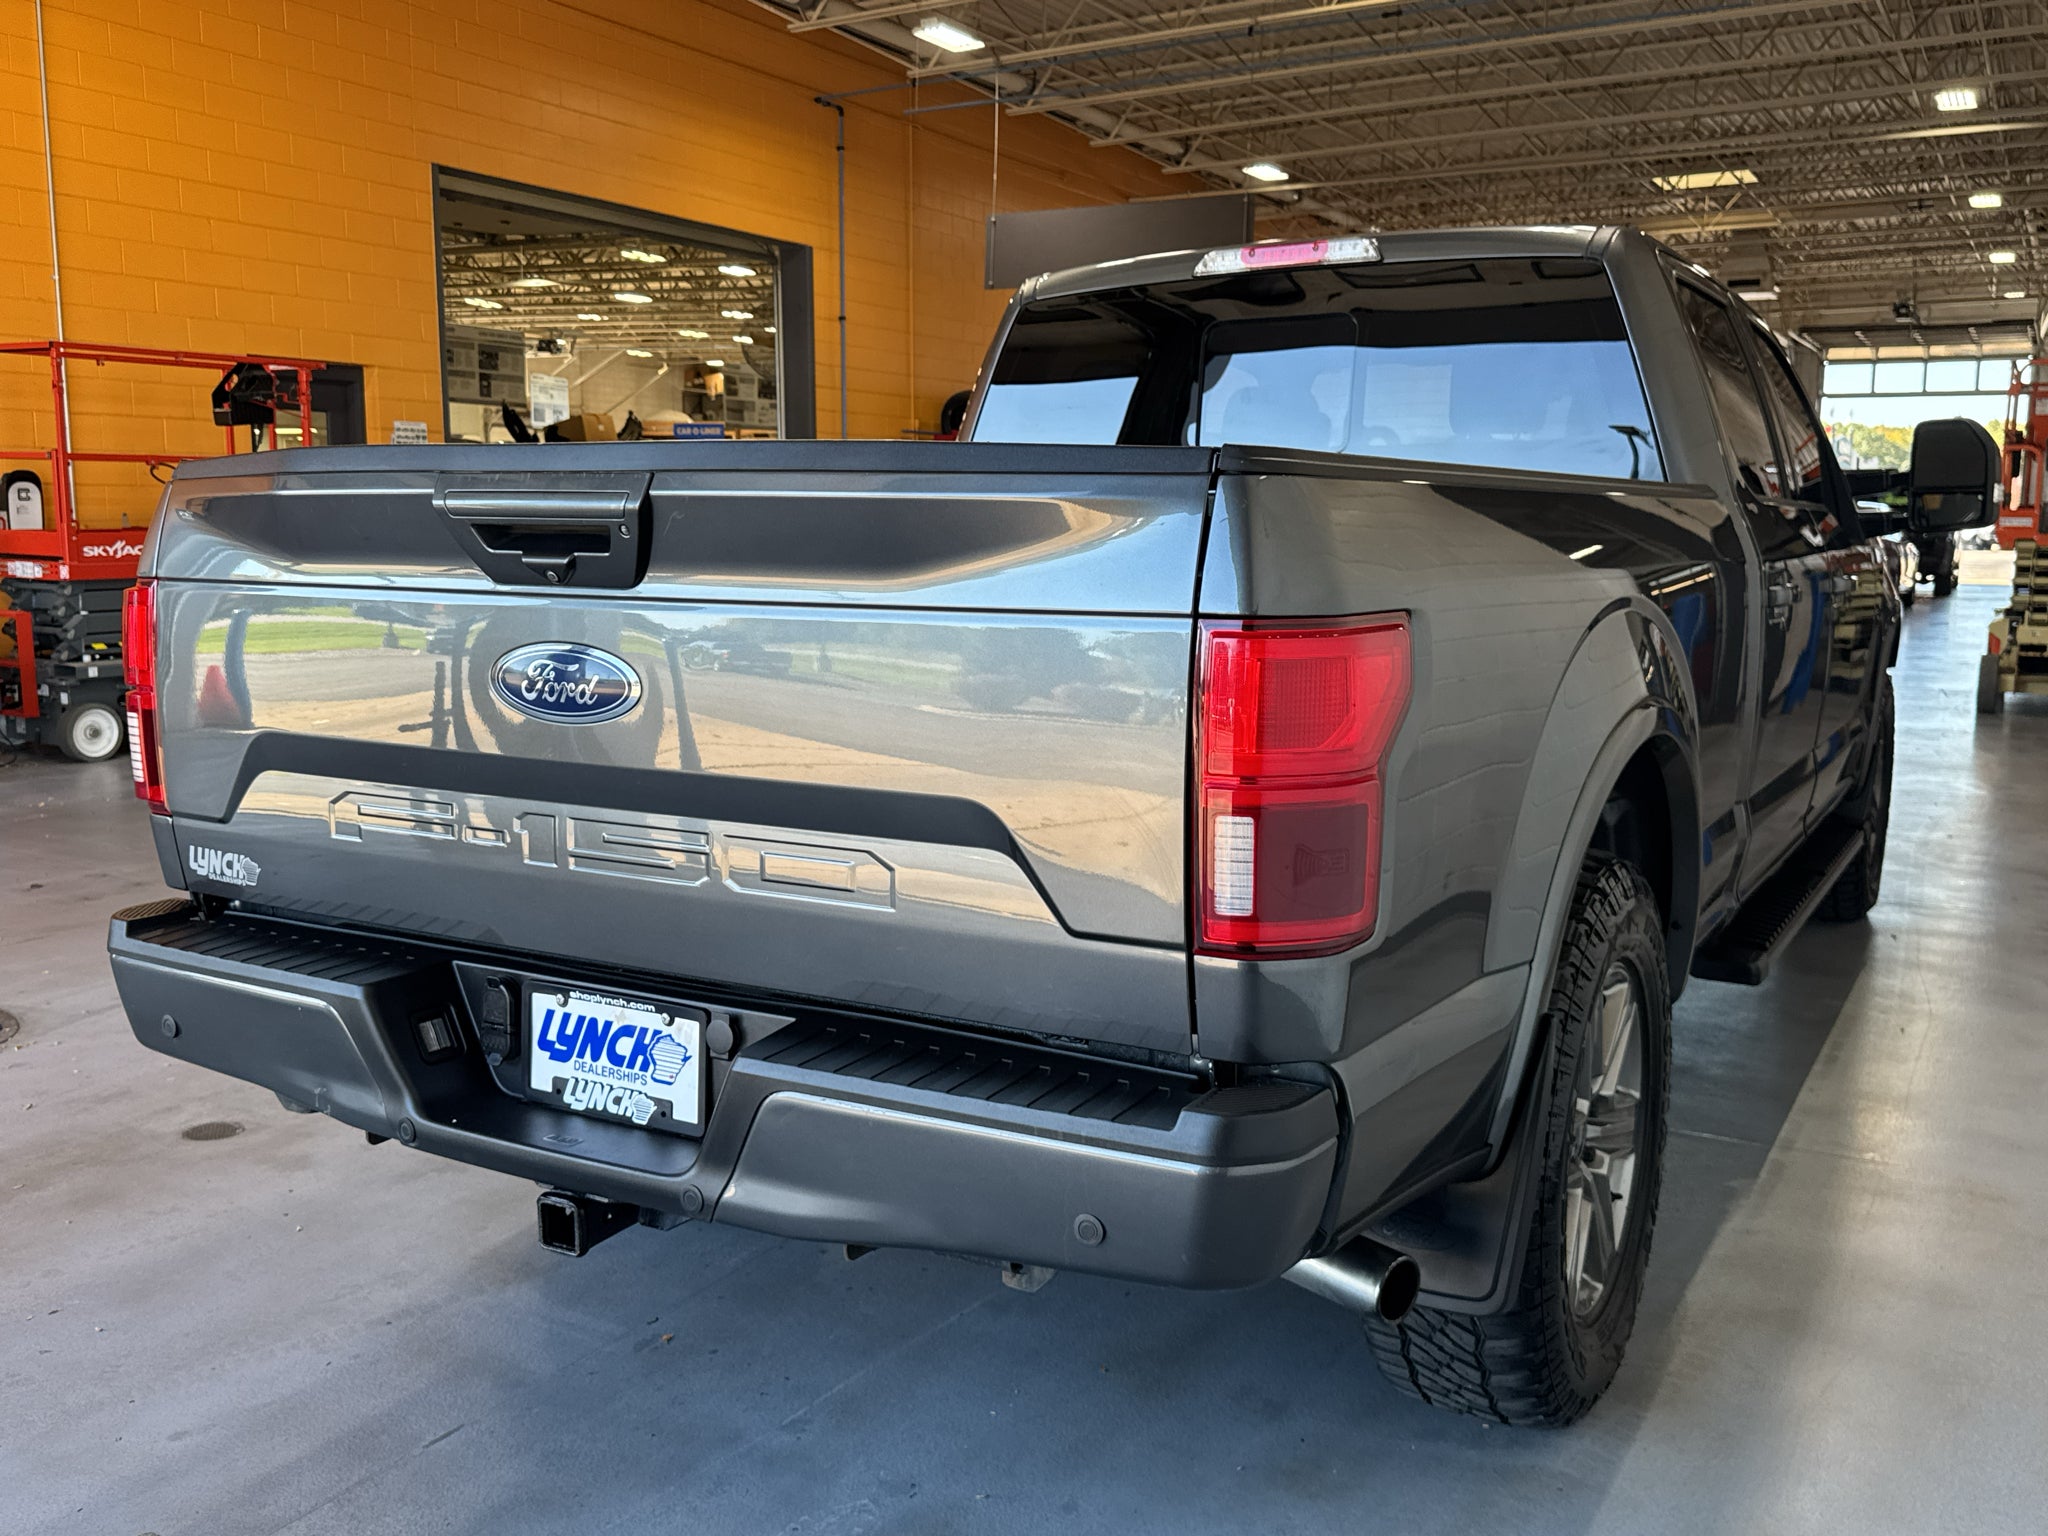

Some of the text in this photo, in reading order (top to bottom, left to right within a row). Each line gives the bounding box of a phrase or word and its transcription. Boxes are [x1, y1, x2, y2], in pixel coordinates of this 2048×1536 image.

[83, 540, 144, 559] SKYJAC
[521, 659, 600, 706] Ford
[188, 845, 246, 880] LYNCH
[329, 790, 896, 913] F-150
[569, 990, 657, 1013] shoplynch.com
[537, 1008, 662, 1073] LYNCH
[573, 1059, 648, 1086] DEALERSHIPS
[563, 1078, 639, 1118] LYNCH
